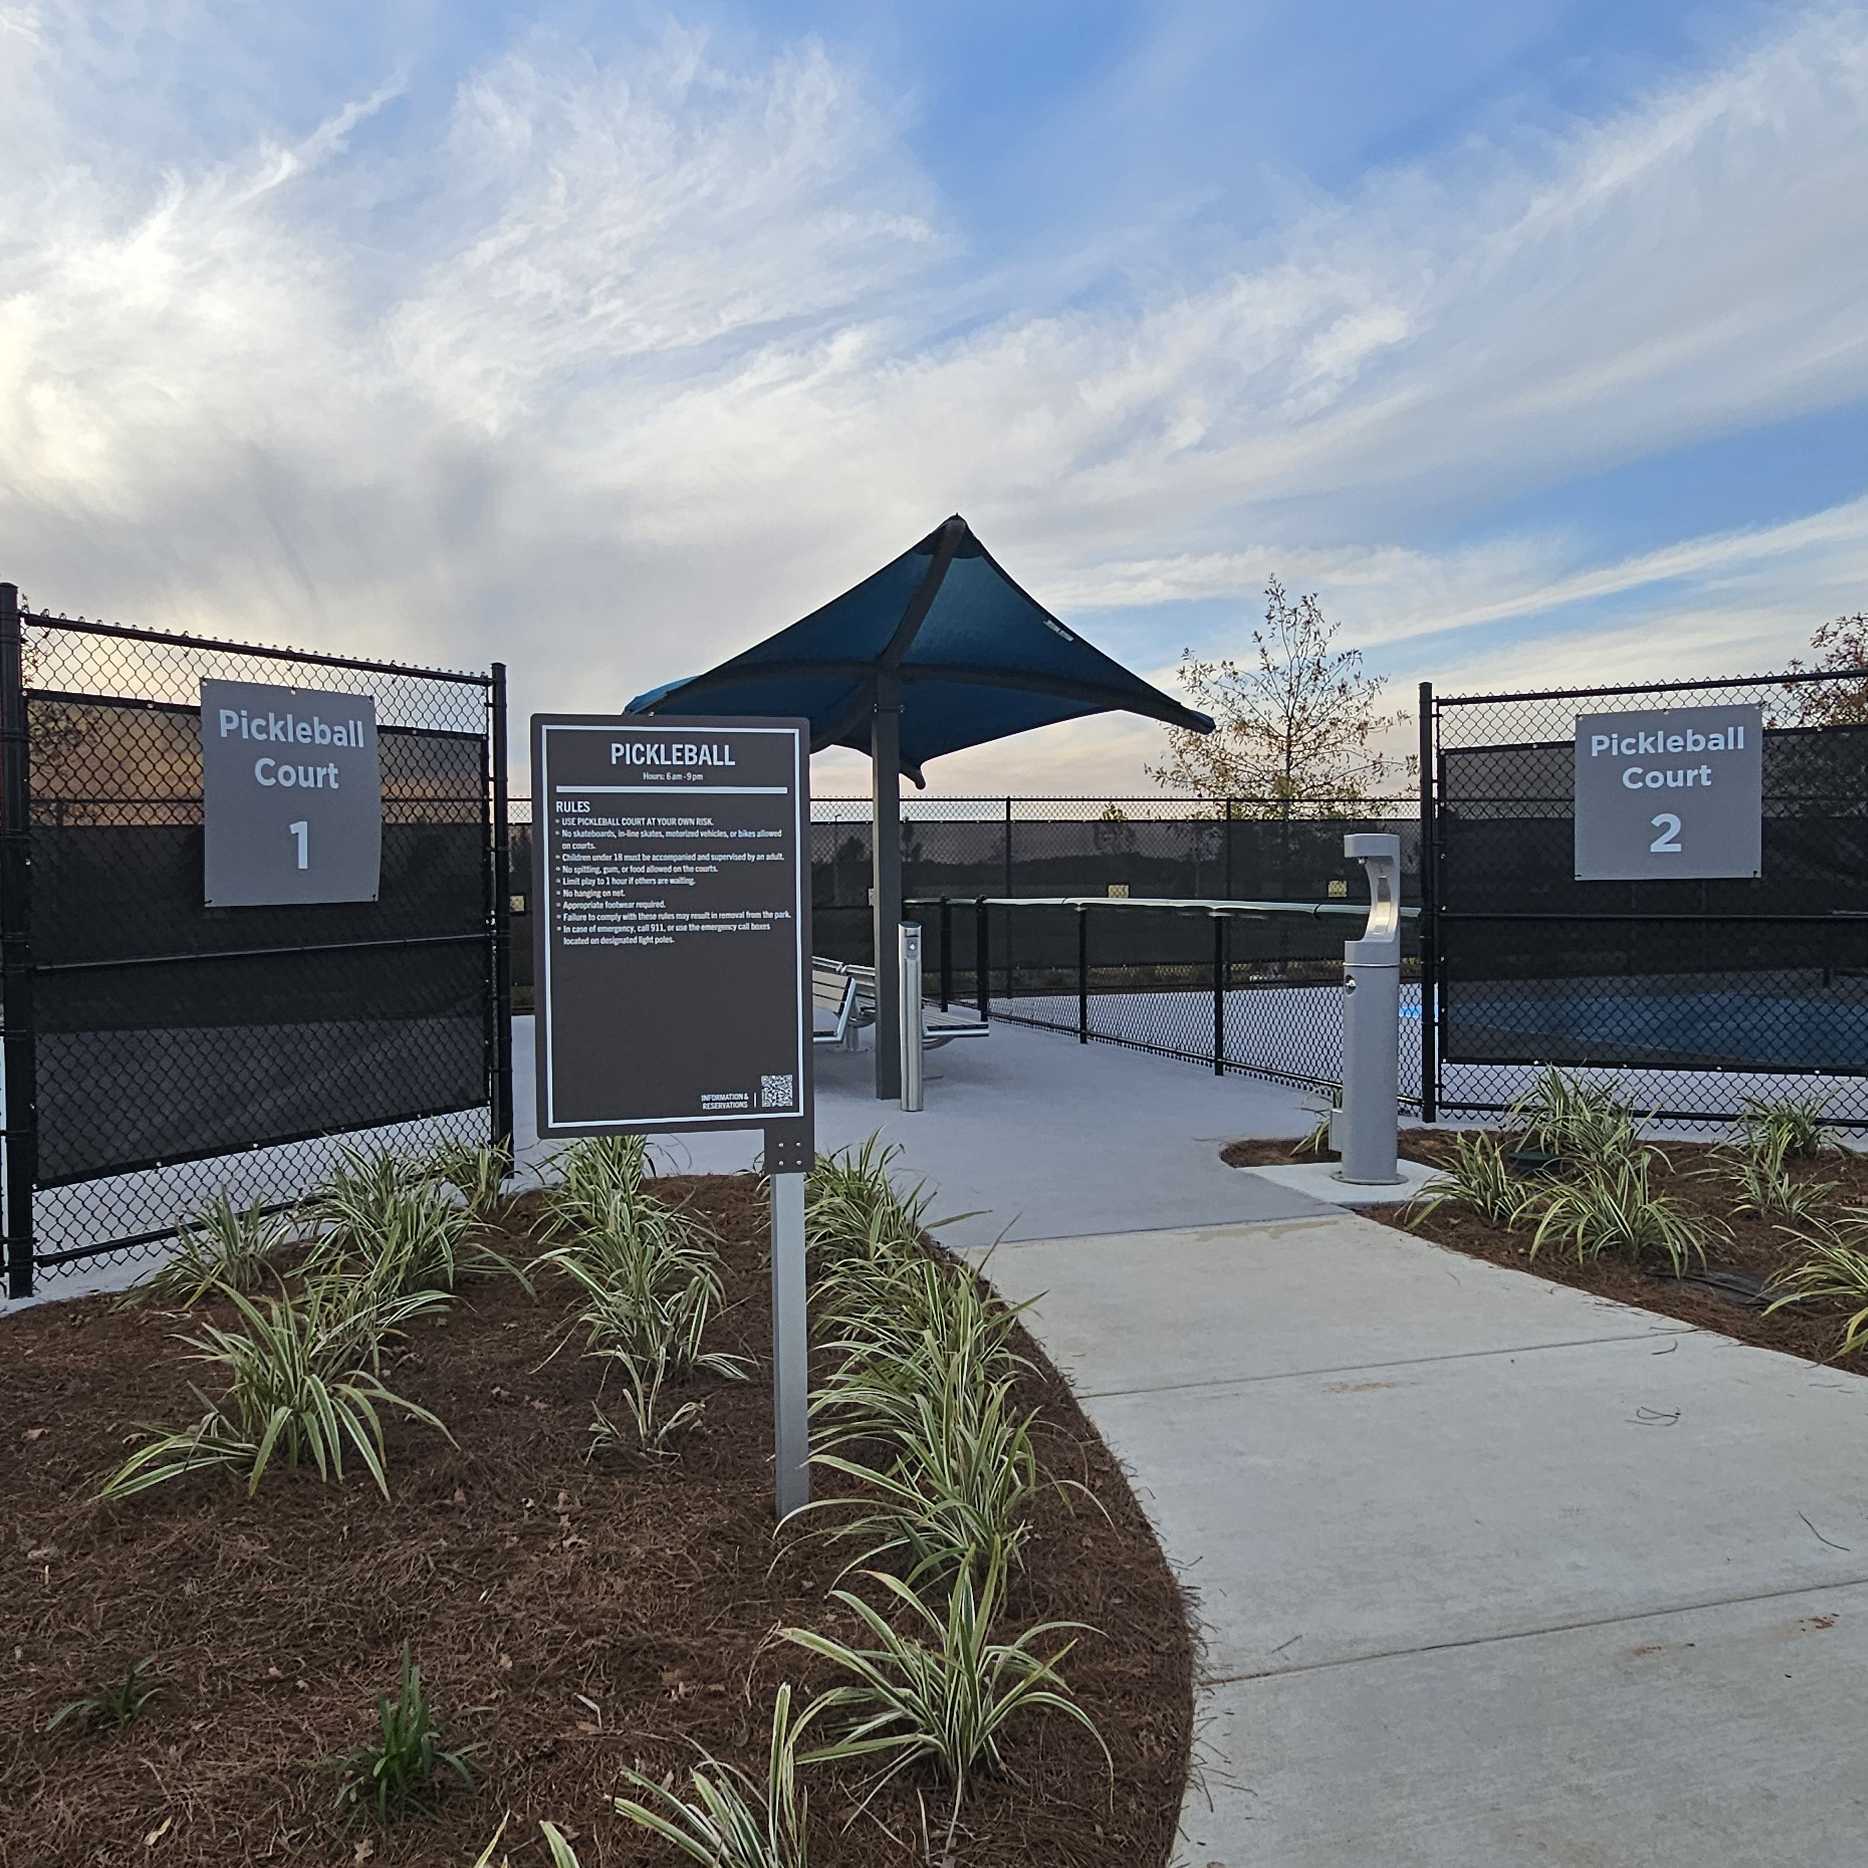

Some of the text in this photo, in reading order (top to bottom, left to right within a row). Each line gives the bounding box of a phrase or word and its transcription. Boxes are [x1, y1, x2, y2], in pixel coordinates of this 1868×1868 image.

[218, 708, 365, 749] Pickleball
[1590, 726, 1745, 757] Pickleball
[611, 743, 736, 766] PICKLEBALL
[253, 756, 340, 790] Court
[643, 772, 665, 781] Hours:
[1622, 765, 1712, 790] Court
[555, 801, 591, 813] RULES
[562, 818, 714, 826] USE PICKLEBALL COURT AT YOUR OWN RISK.
[572, 830, 617, 838] skateboards,
[618, 830, 639, 838] in-line
[640, 830, 664, 838] skates,
[665, 830, 699, 838] motorized
[700, 830, 729, 838] vehicles,
[738, 830, 756, 838] bikes
[757, 830, 782, 838] allowed
[1649, 813, 1682, 854] 2
[289, 821, 309, 870] 1
[572, 842, 596, 850] courts.
[562, 853, 591, 862] Children
[592, 853, 613, 862] under
[614, 853, 623, 862] 18
[641, 853, 651, 861] be
[651, 853, 696, 862] accompanied
[697, 853, 710, 861] and
[710, 853, 746, 863] supervised
[747, 853, 755, 862] by
[765, 853, 784, 861] adult.
[574, 865, 601, 875] spitting,
[603, 866, 620, 875] gum,
[630, 865, 645, 873] food
[646, 865, 673, 873] allowed
[683, 865, 694, 873] the
[562, 877, 580, 886] Limit
[581, 877, 596, 887] play
[606, 877, 610, 885] 1
[611, 877, 628, 885] hour
[628, 877, 634, 885] if
[635, 877, 656, 885] others
[670, 877, 696, 886] waiting.
[562, 889, 573, 897] No
[574, 889, 601, 899] hanging
[612, 889, 626, 897] net.
[562, 900, 666, 911] Appropriate footwear required.
[563, 913, 587, 922] Failure
[596, 913, 622, 922] comply
[622, 913, 637, 921] with
[638, 912, 657, 920] these
[657, 912, 675, 921] rules
[676, 913, 690, 921] may
[690, 911, 710, 919] result
[711, 911, 718, 919] in
[718, 911, 745, 919] removal
[774, 911, 791, 919] park.
[563, 925, 571, 933] In
[588, 925, 596, 933] of
[597, 926, 636, 934] emergency,
[637, 924, 650, 932] call
[688, 923, 700, 931] the
[700, 924, 737, 932] emergency
[738, 923, 750, 931] call
[751, 923, 770, 931] boxes
[563, 937, 589, 945] located
[600, 936, 638, 946] designated
[638, 936, 654, 945] light
[654, 936, 675, 945] poles.
[701, 1092, 749, 1101] INFORMATION &
[702, 1101, 748, 1110] RESERVATIONS
